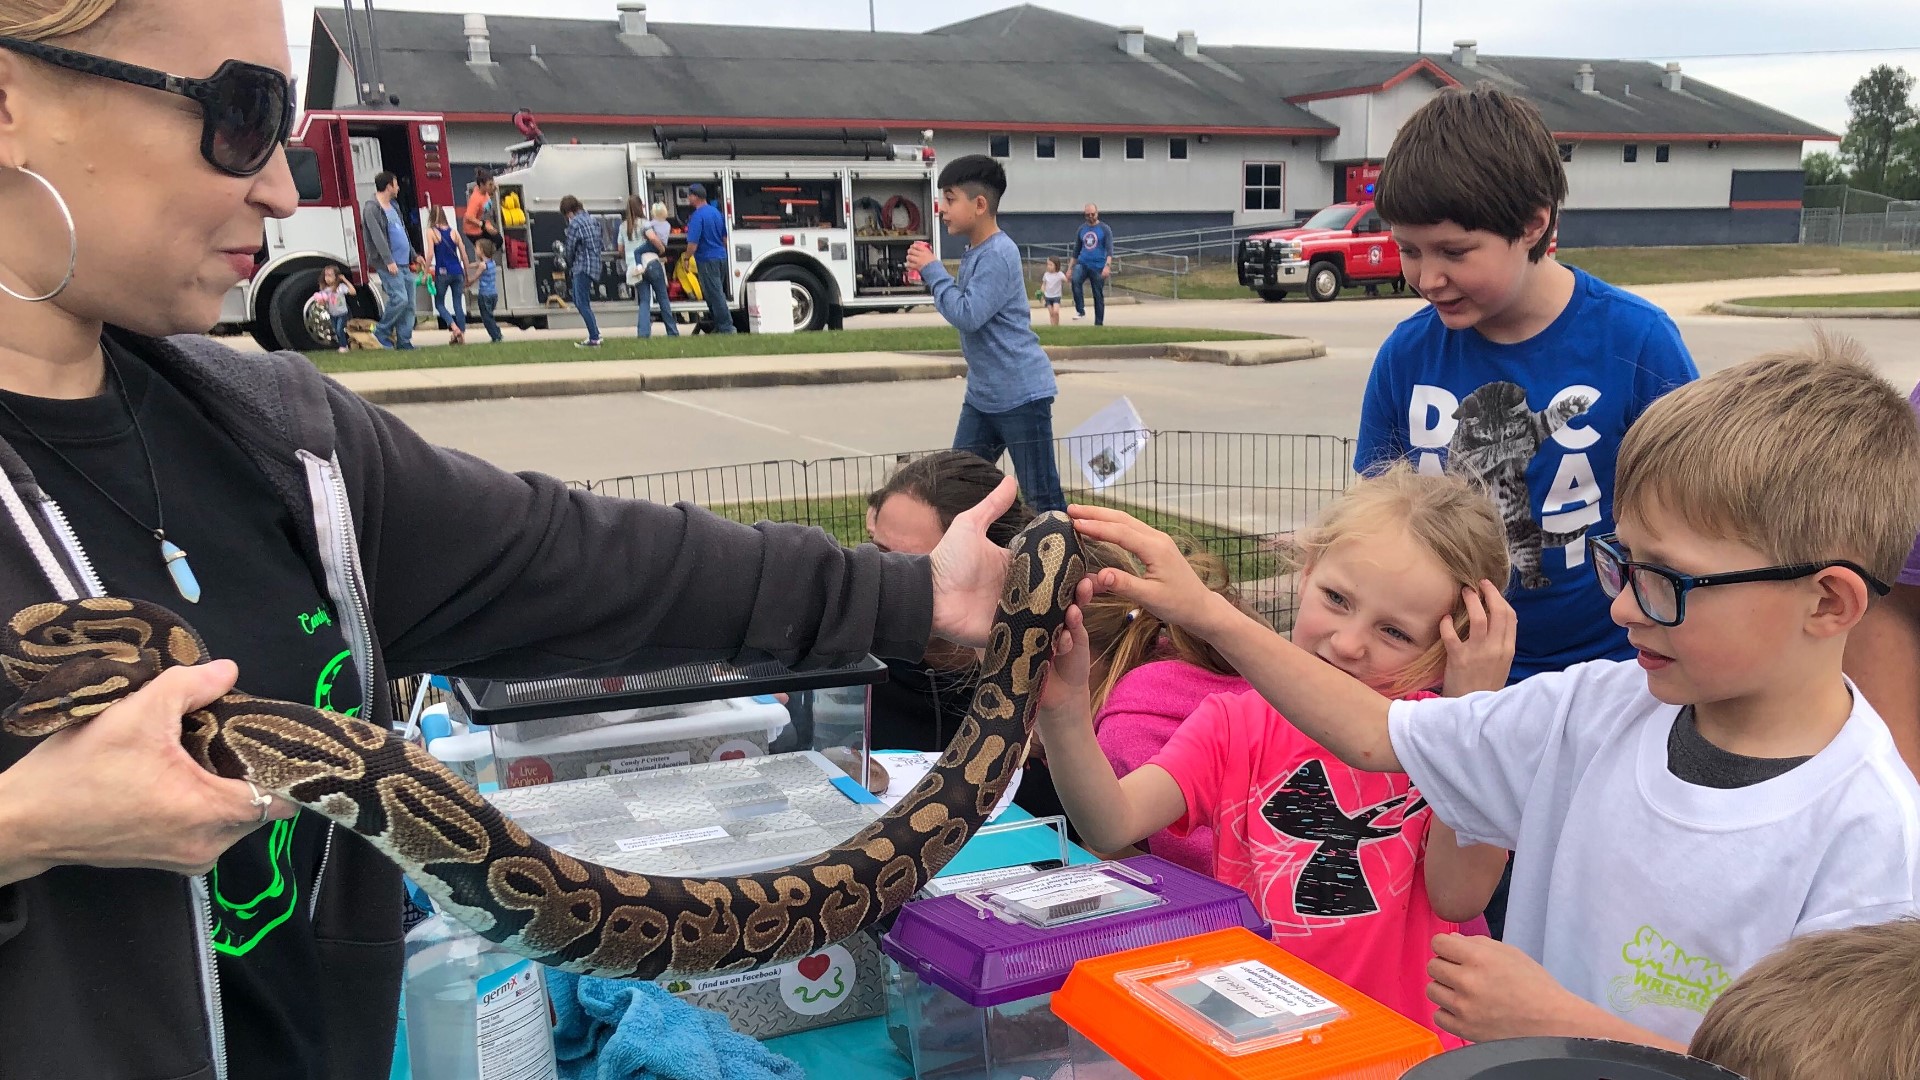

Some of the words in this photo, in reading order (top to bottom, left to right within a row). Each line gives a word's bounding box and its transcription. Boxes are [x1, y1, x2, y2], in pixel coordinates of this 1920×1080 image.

[620, 759, 640, 767] Candy
[646, 755, 670, 764] Critters
[634, 763, 657, 772] Animal
[658, 760, 689, 770] Education
[520, 766, 538, 777] Live
[698, 979, 718, 991] (find
[742, 967, 782, 982] Facebook)
